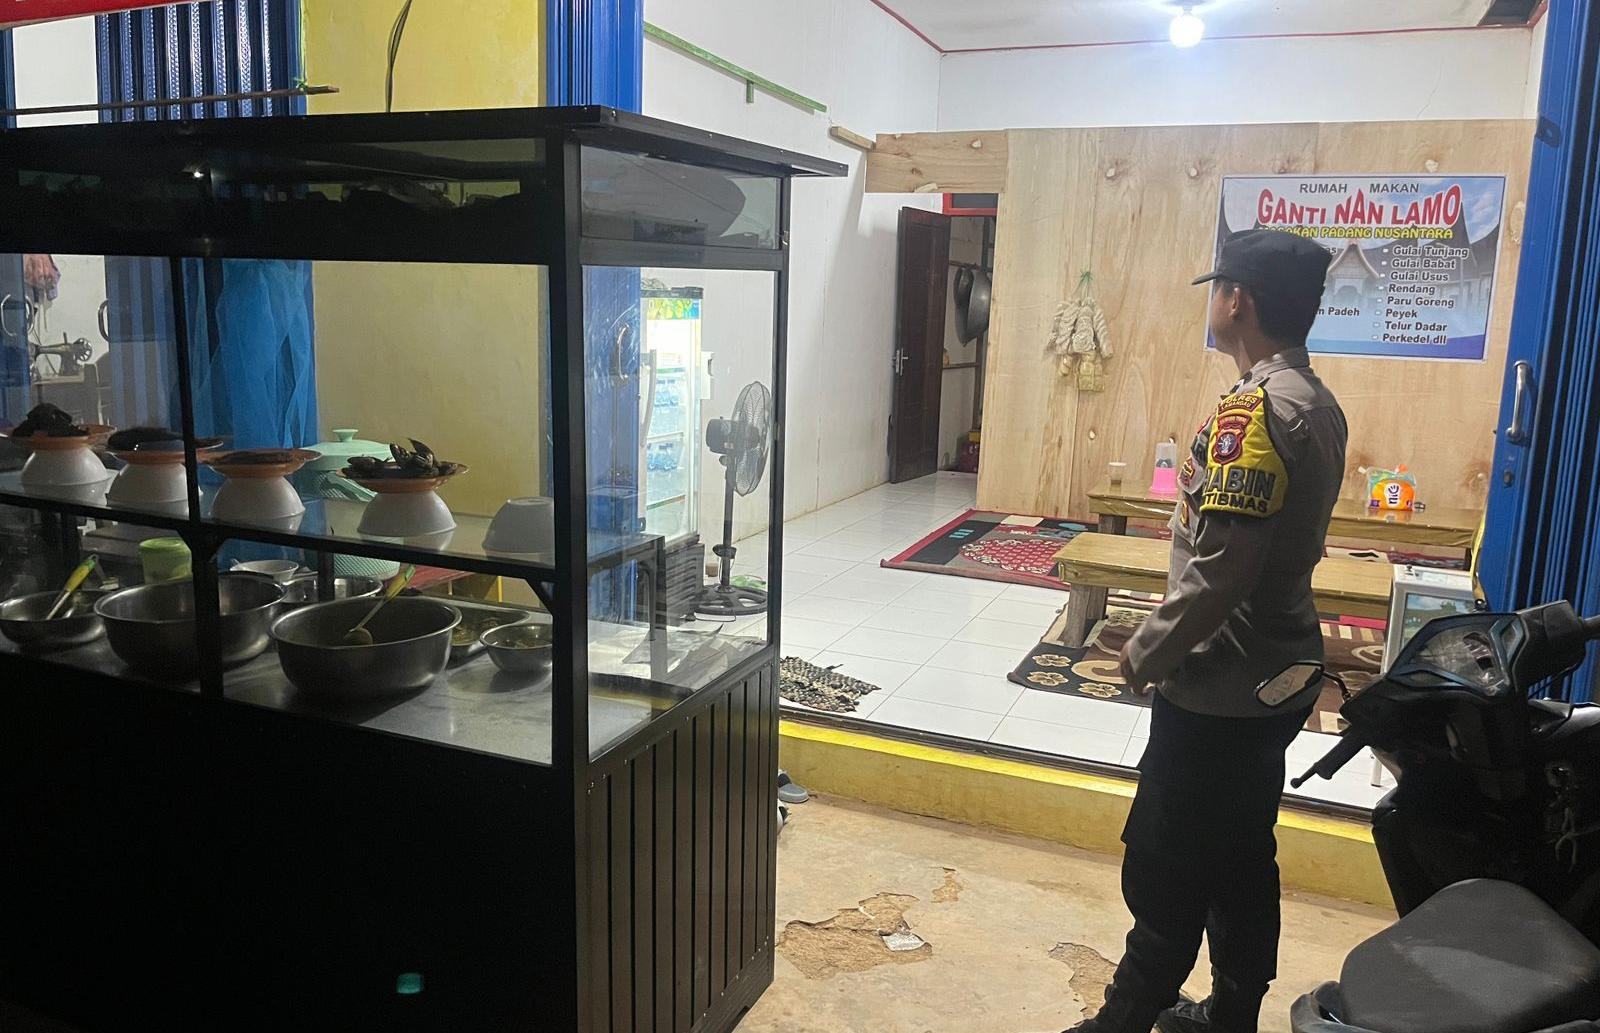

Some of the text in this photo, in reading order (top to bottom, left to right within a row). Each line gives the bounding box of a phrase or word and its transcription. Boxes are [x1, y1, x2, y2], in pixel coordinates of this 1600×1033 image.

[1299, 183, 1420, 194] RUMAH MAKAN
[1257, 184, 1461, 226] GANTI NAN LAMO
[1320, 227, 1372, 239] PADANG
[1374, 227, 1453, 239] NUSANTARA
[1393, 246, 1468, 258] Gulai Tunjang
[1392, 259, 1456, 269] Gulai Babat
[1390, 271, 1449, 281] Gulai Usus
[1388, 284, 1436, 295] Rendang
[1387, 296, 1455, 308] Paru Goreng
[1328, 306, 1360, 317] Padeh
[1385, 309, 1418, 320] Peyek
[1384, 321, 1448, 332] Telur Dadar
[1382, 333, 1447, 344] Perkedel dll
